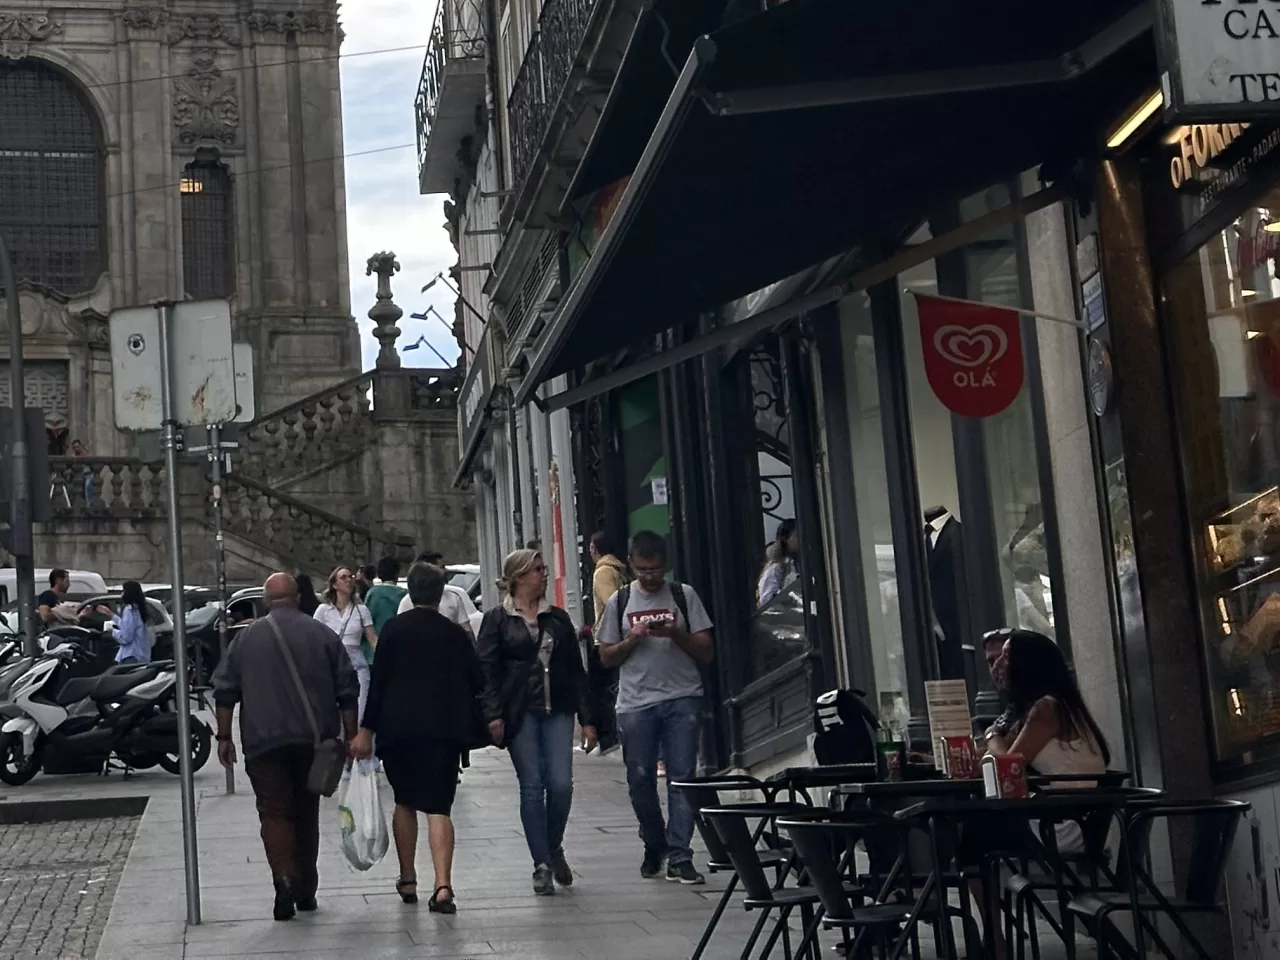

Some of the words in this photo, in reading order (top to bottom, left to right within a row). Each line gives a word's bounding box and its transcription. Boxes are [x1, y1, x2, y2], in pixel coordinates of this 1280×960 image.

[1223, 9, 1280, 40] CA
[1181, 123, 1251, 180] FOR
[953, 366, 996, 387] OLÁ
